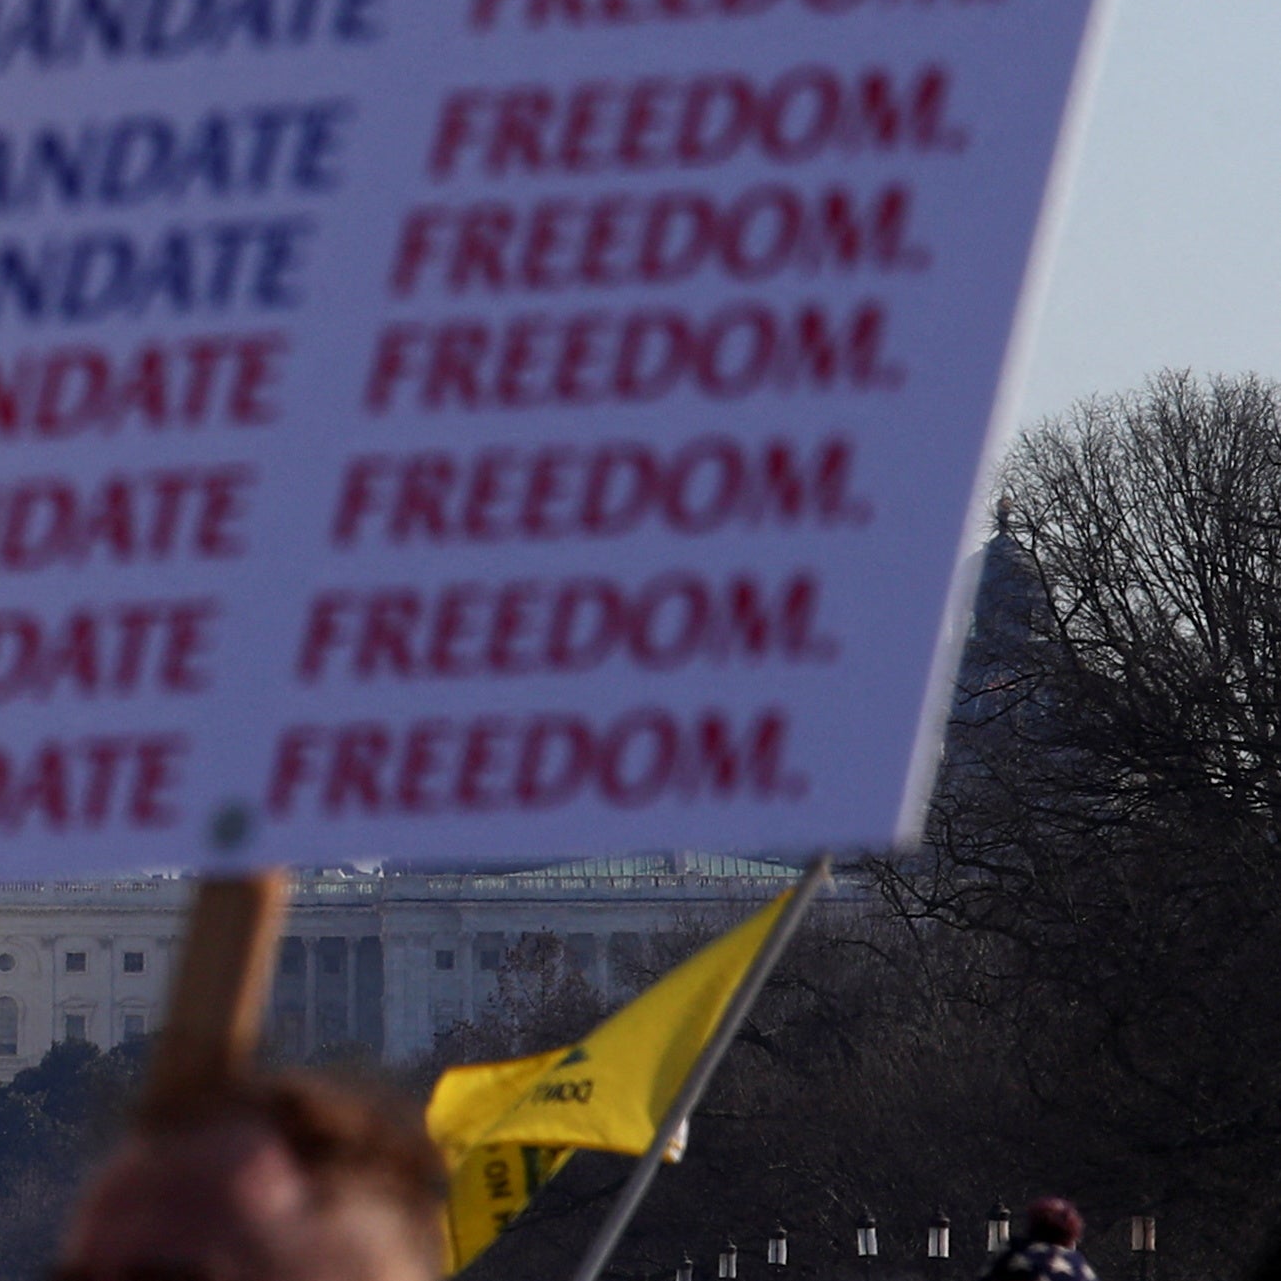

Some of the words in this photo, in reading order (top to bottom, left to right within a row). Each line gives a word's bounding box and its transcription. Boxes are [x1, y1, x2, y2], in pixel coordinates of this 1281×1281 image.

[427, 63, 968, 181] FREEDOM.
[388, 181, 930, 299] FREEDOM.
[363, 298, 904, 416] FREEDOM.
[330, 433, 872, 549] FREEDOM.
[295, 569, 837, 685] FREEDOM.
[262, 706, 807, 820] FREEDOM.
